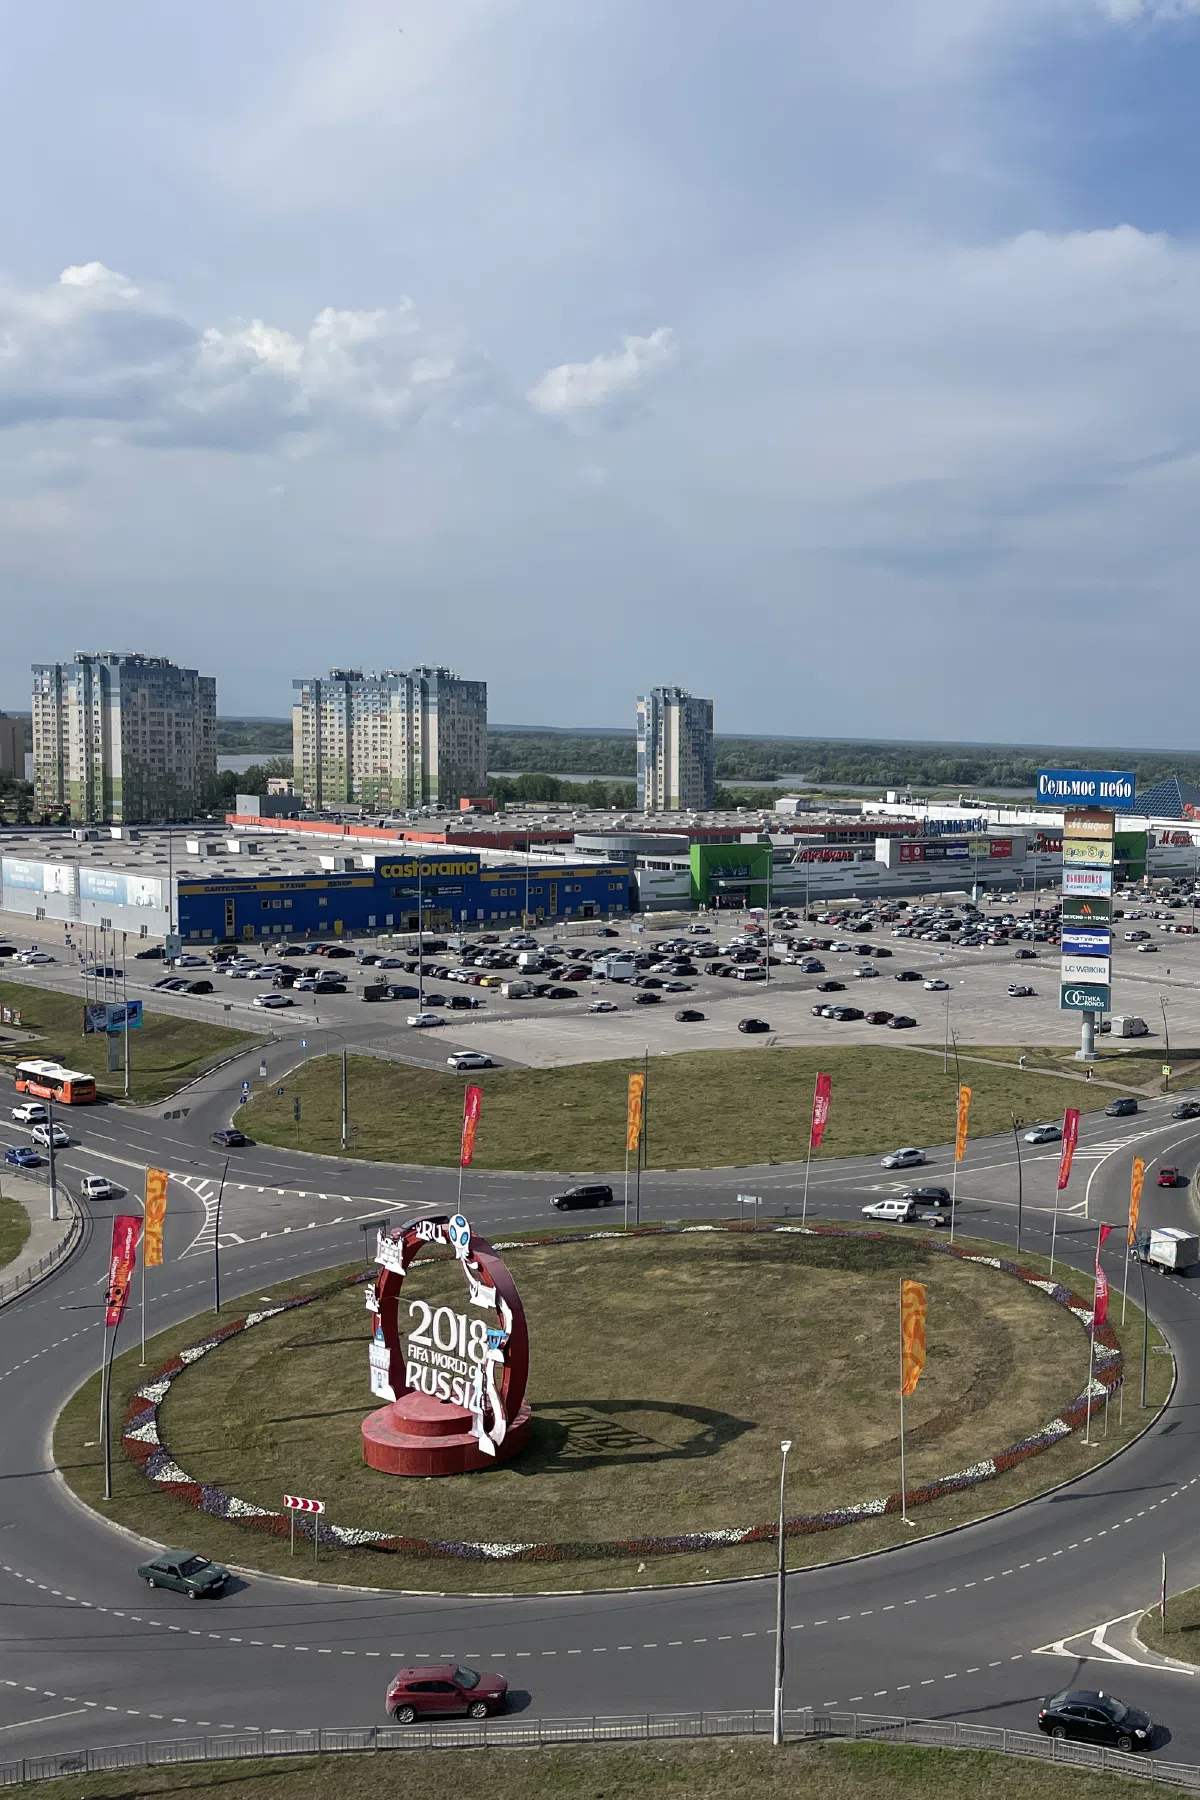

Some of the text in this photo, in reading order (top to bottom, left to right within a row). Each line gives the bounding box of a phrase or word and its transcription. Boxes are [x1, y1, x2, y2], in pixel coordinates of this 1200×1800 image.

[1040, 774, 1132, 798] Седьмое небо
[380, 861, 478, 878] castorama
[1065, 965, 1076, 973] LC
[408, 1300, 488, 1365] 2018
[407, 1344, 430, 1363] FIFA
[430, 1350, 468, 1376] WORLD
